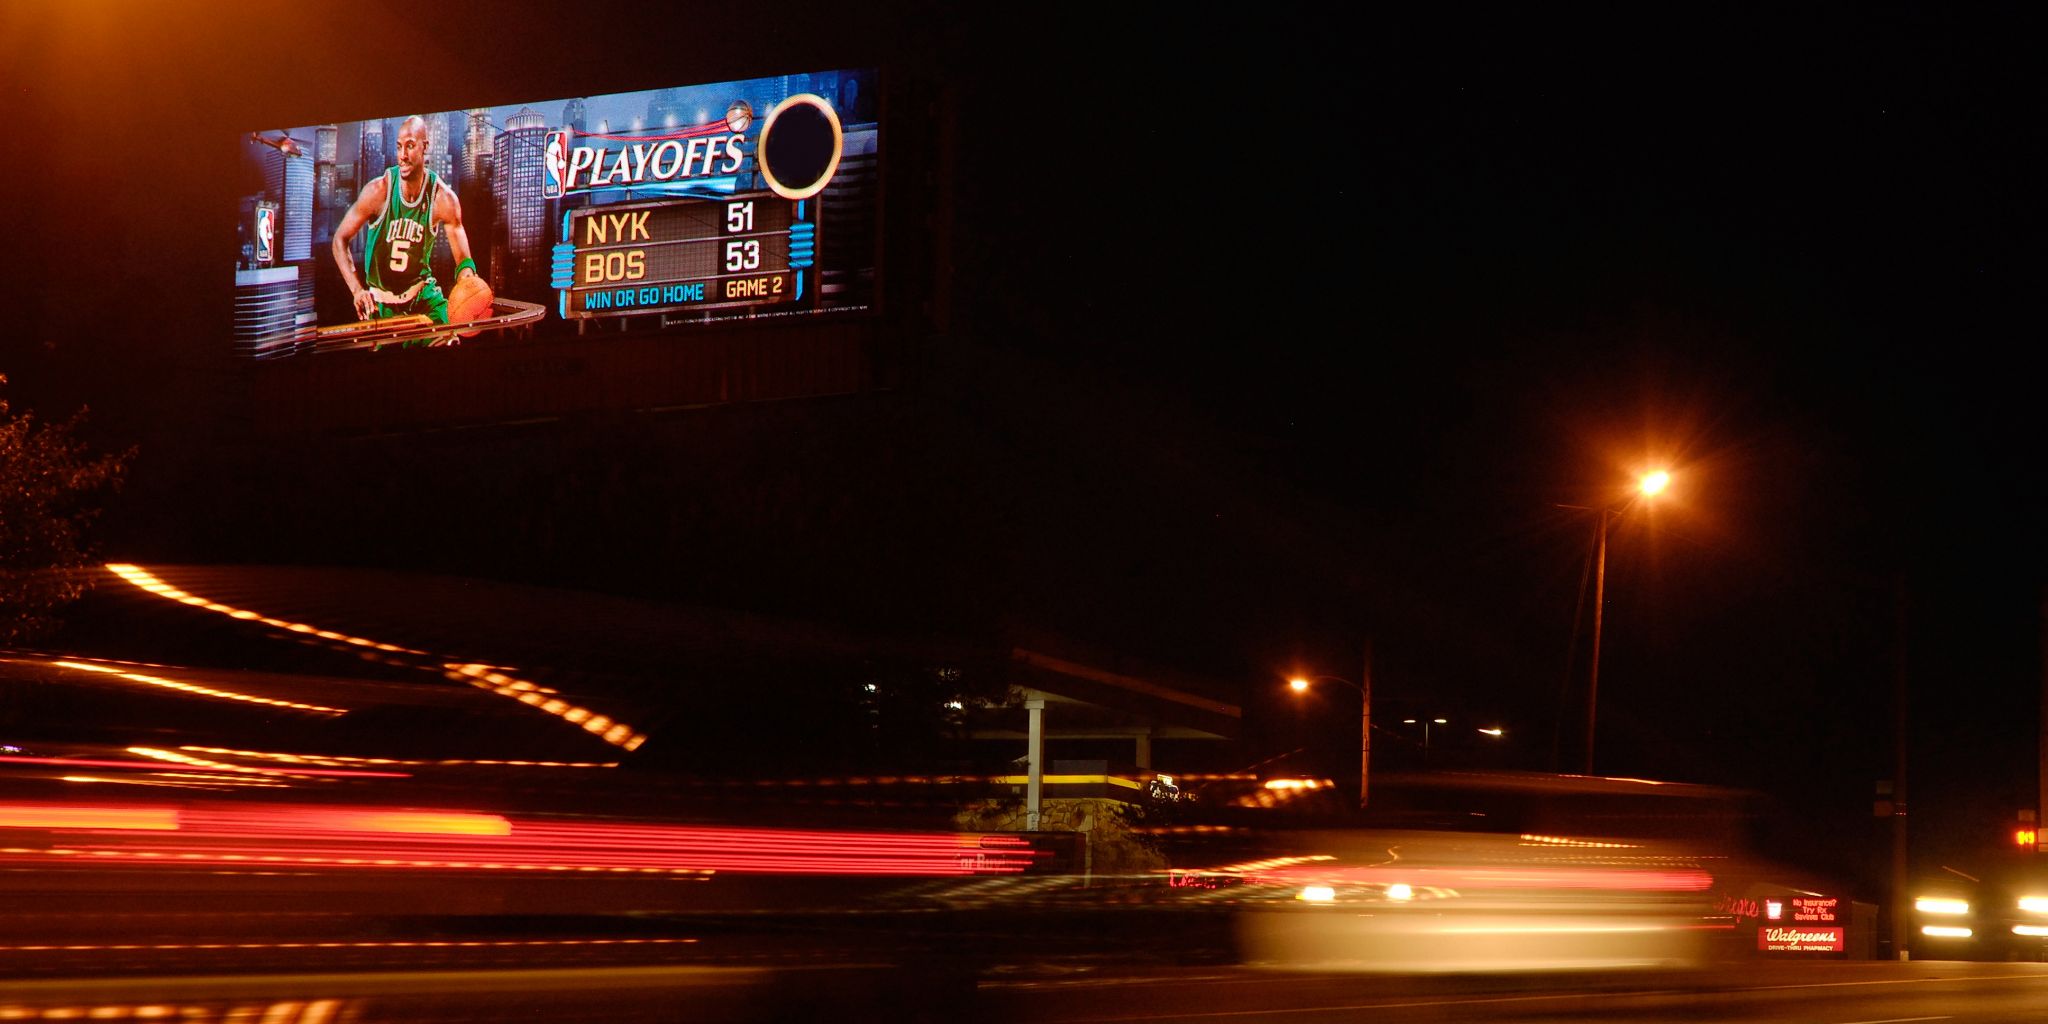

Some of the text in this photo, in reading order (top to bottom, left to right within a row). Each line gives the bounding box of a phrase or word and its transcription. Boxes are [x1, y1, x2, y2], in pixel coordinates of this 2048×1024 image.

[566, 133, 745, 188] PLAYOFFS
[387, 218, 424, 243] CELTICS
[586, 201, 754, 245] NYK 51
[391, 241, 411, 272] 5
[585, 240, 760, 283] BOS 53
[585, 283, 704, 311] WIN OR GO HOME
[726, 275, 783, 299] GAME 2
[1793, 899, 1837, 907] No Insurance?
[1803, 906, 1815, 914] Try
[1821, 913, 1834, 921] Club
[1765, 928, 1837, 946] Walgreens
